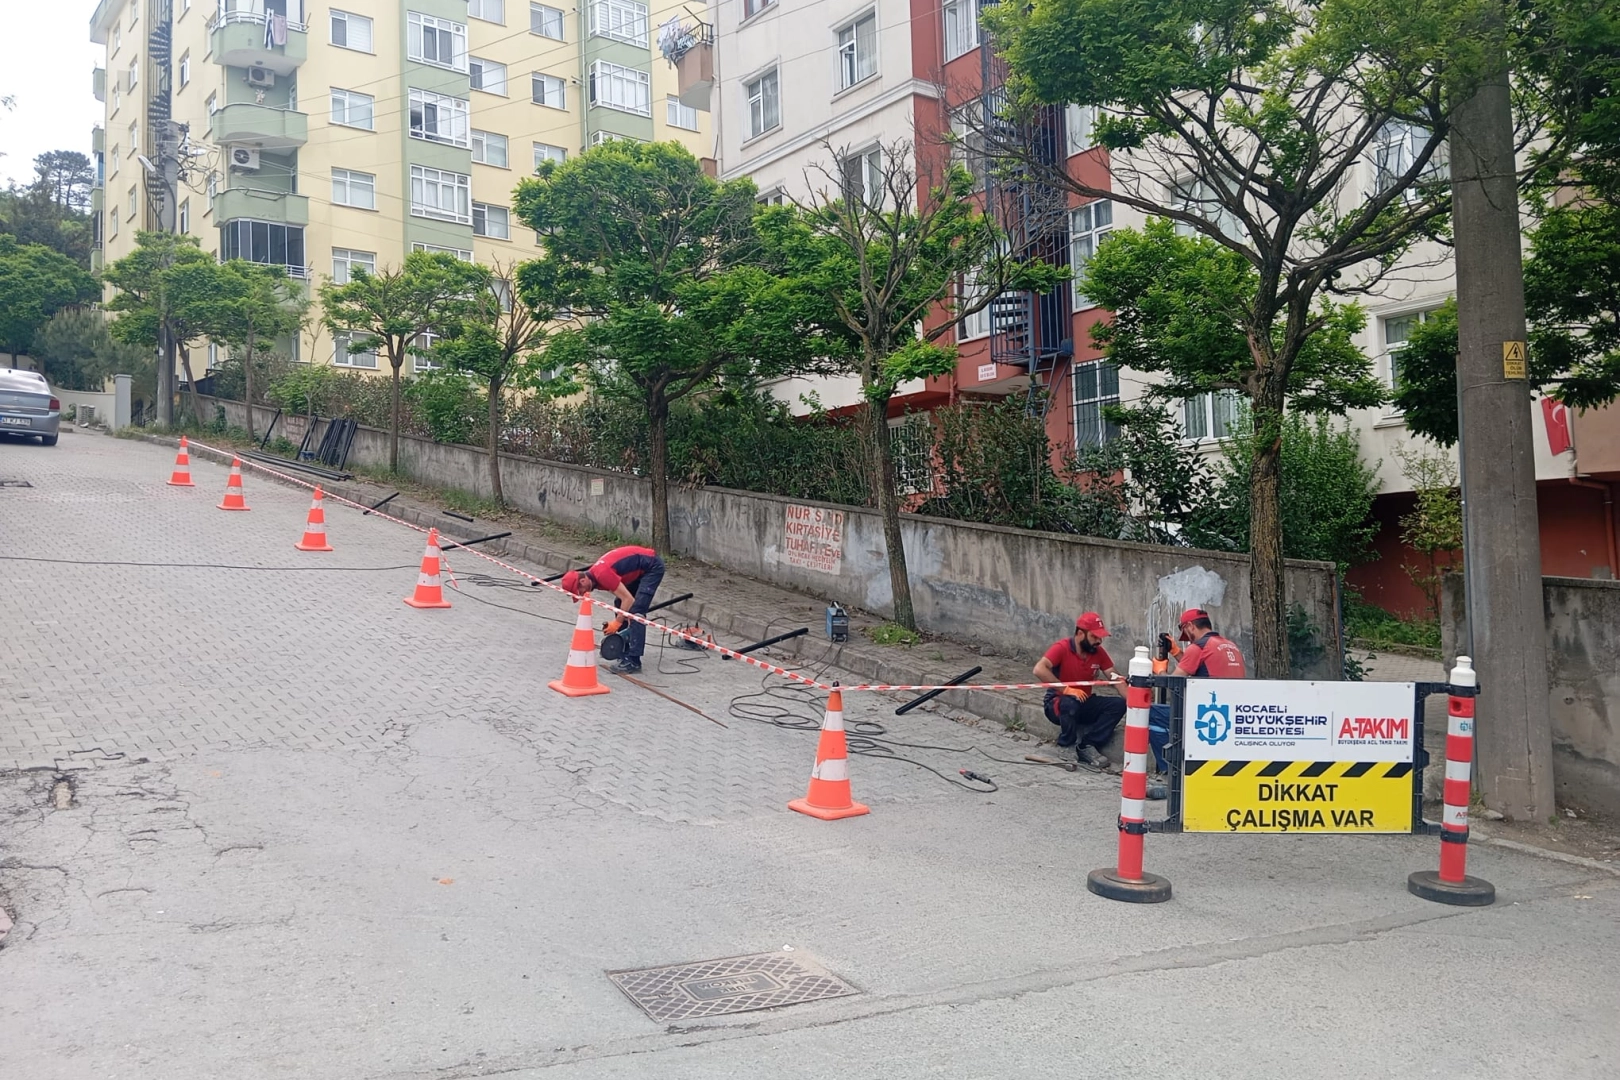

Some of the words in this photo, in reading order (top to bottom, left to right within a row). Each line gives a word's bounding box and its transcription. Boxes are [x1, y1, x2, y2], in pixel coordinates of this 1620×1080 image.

[787, 505, 810, 520] NUR
[1259, 779, 1338, 802] DİKKAT
[1226, 809, 1325, 832] ÇALIŞMA
[1331, 810, 1374, 827] VAR
